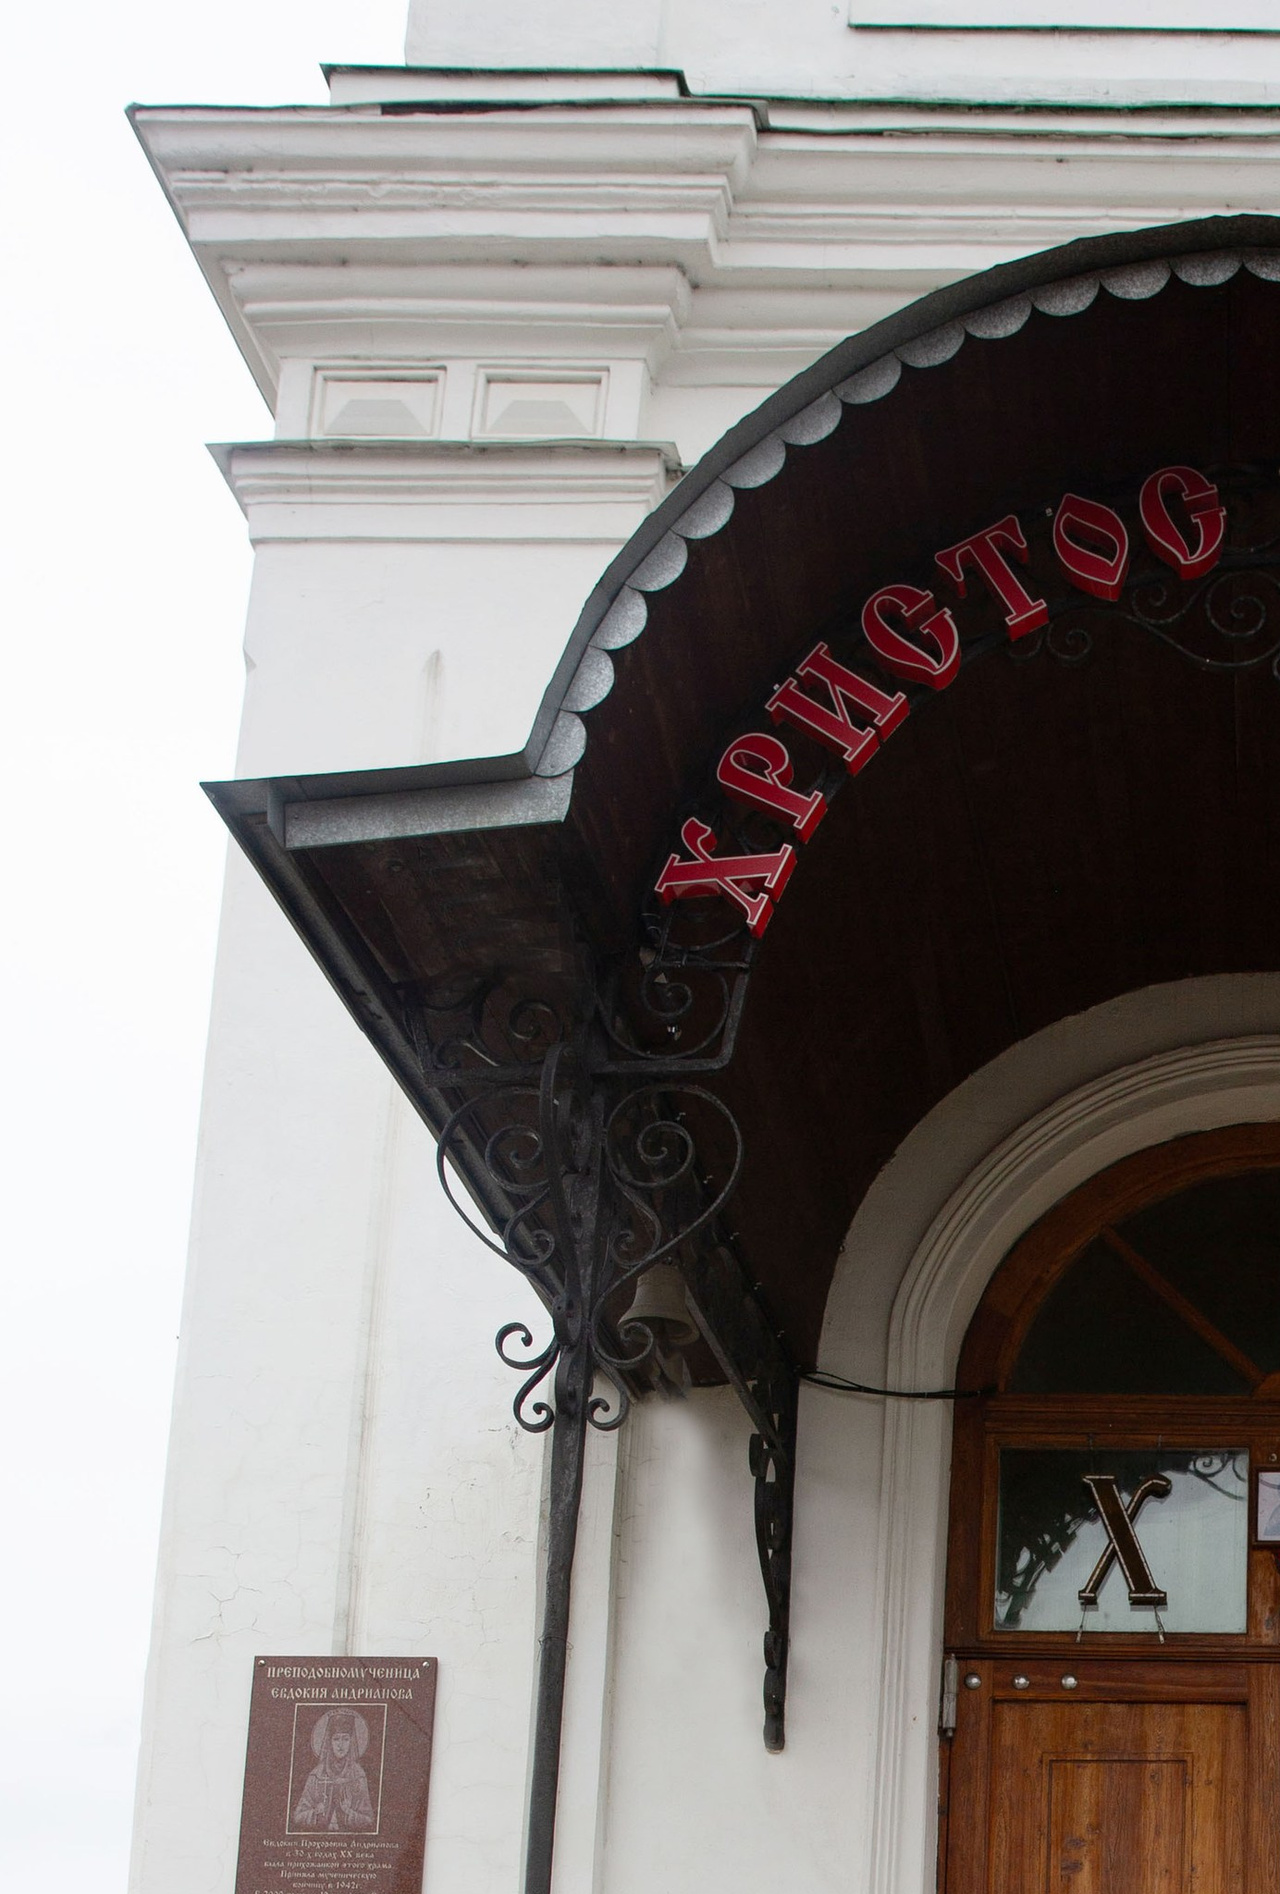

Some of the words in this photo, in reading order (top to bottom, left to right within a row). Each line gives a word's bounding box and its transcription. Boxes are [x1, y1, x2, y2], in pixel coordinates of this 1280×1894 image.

[654, 465, 1227, 939] ХРИСТОС
[267, 1666, 421, 1680] ПРЕПОДОБНОМУЧЕНИЦА
[331, 1688, 413, 1700] АНДРИАНОВА
